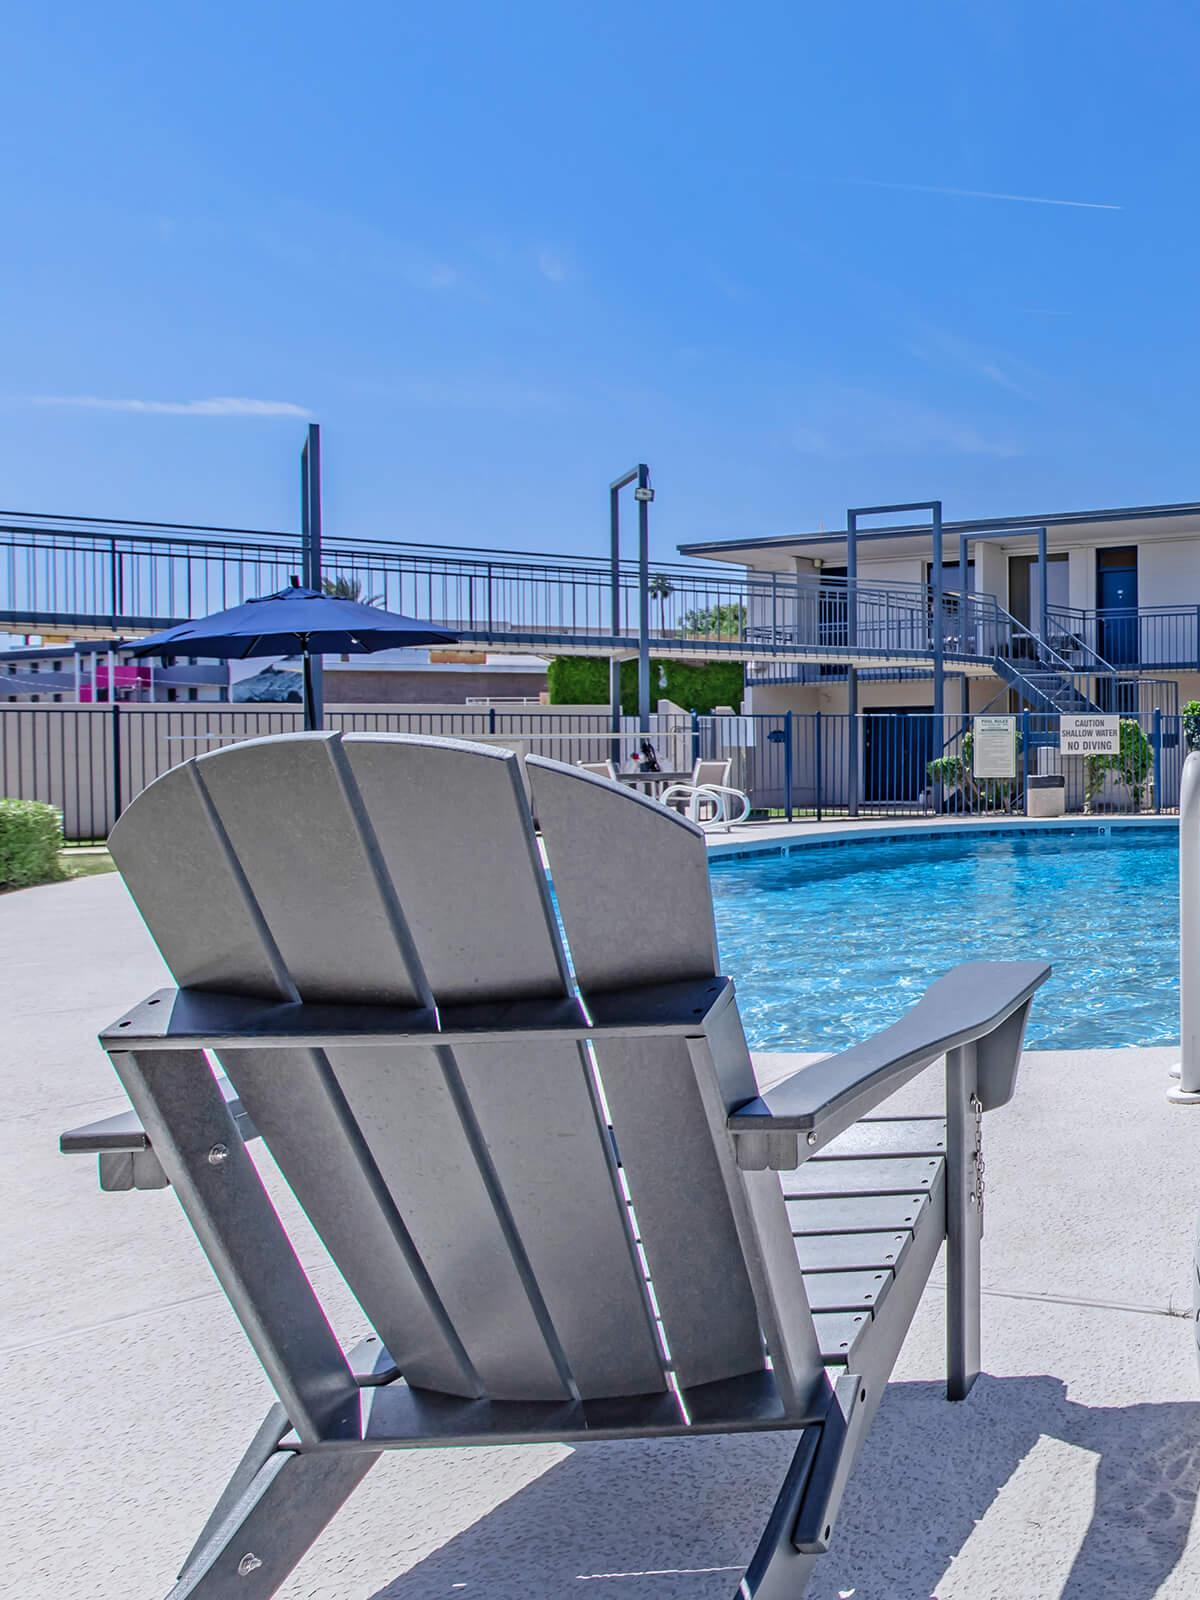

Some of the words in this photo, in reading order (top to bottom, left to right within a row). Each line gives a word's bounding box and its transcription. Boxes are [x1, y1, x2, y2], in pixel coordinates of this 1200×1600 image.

[1075, 719, 1104, 727] CAUTION
[1062, 729, 1093, 737] SHALLOW
[1068, 741, 1079, 750] NO
[1083, 741, 1112, 750] DIVING
